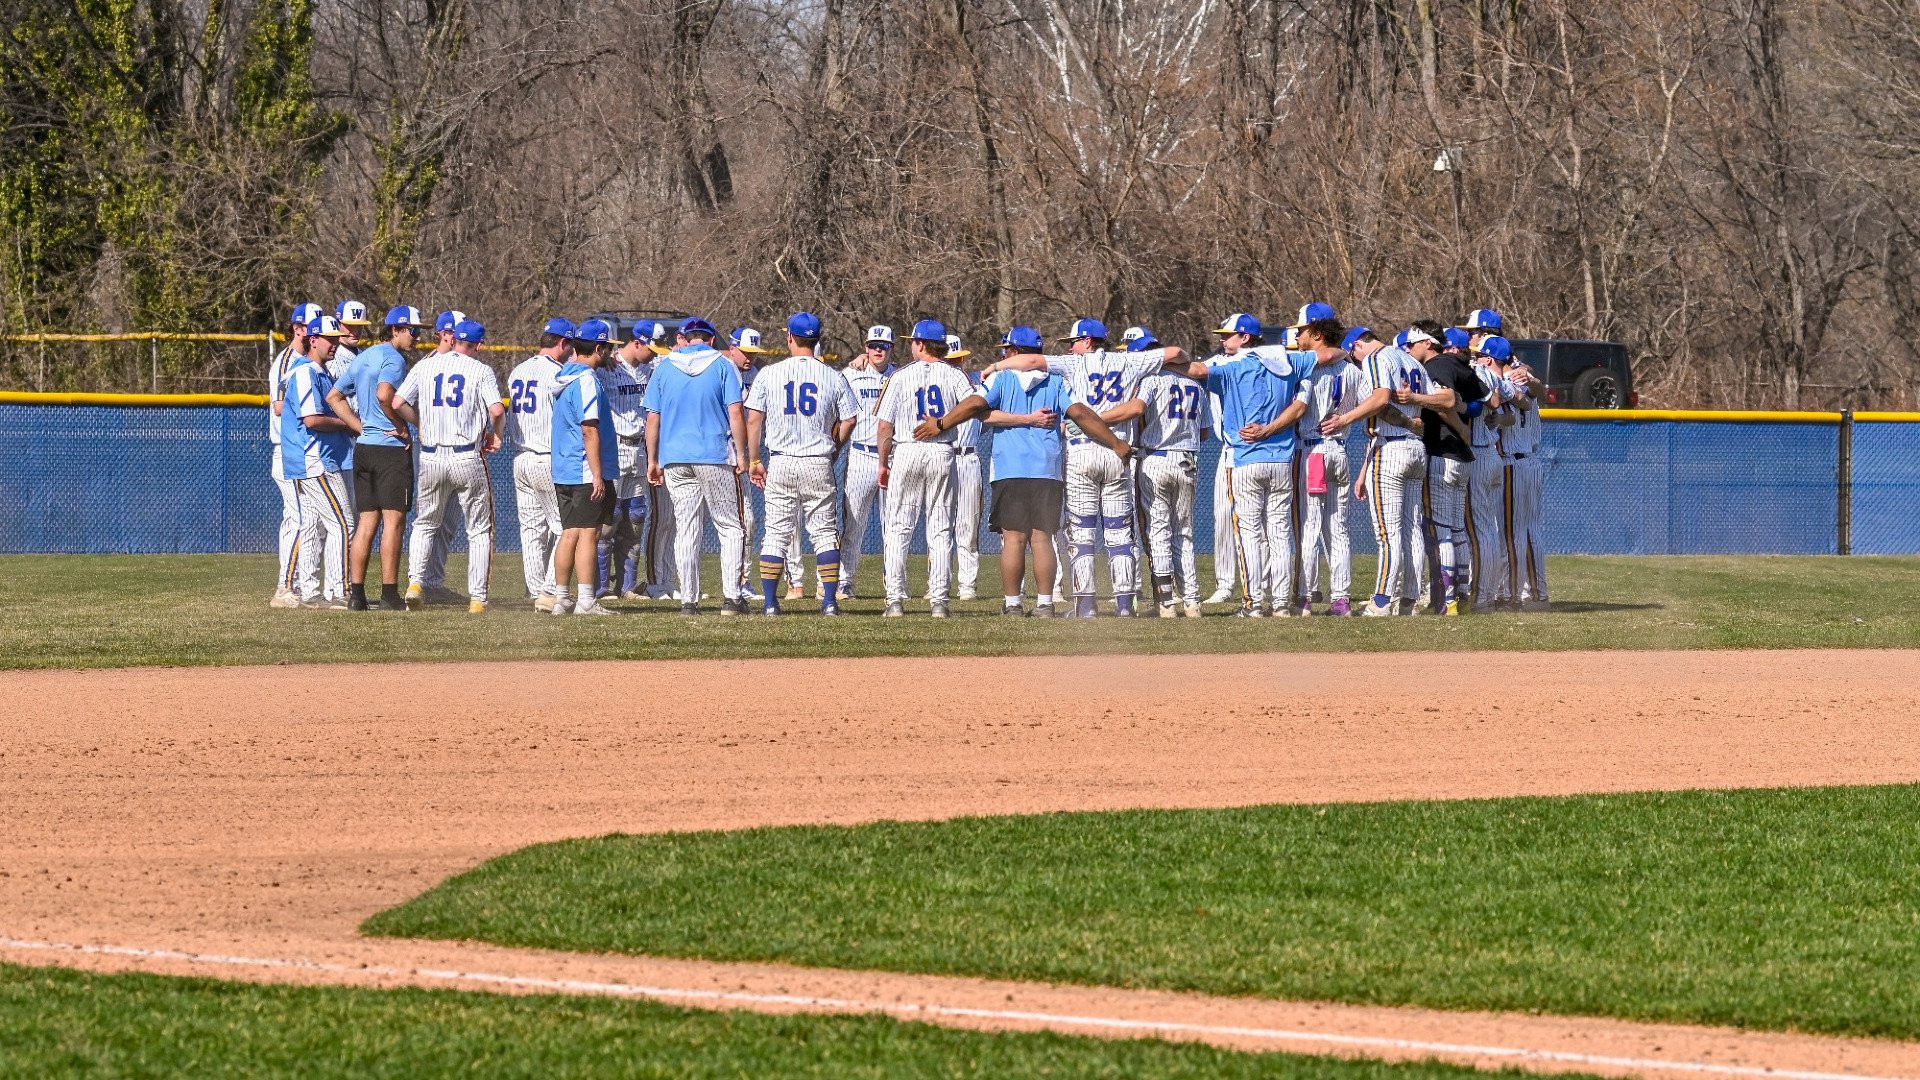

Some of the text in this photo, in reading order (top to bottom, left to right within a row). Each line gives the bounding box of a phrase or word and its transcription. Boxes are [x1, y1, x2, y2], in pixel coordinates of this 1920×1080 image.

[330, 321, 339, 330] W
[351, 309, 363, 319] W
[750, 336, 759, 346] W
[873, 328, 884, 337] W
[950, 341, 959, 351] W
[432, 373, 465, 407] 13
[511, 379, 538, 414] 25
[784, 381, 818, 416] 16
[915, 384, 945, 420] 19
[1087, 371, 1123, 405] 33
[1168, 384, 1199, 420] 27
